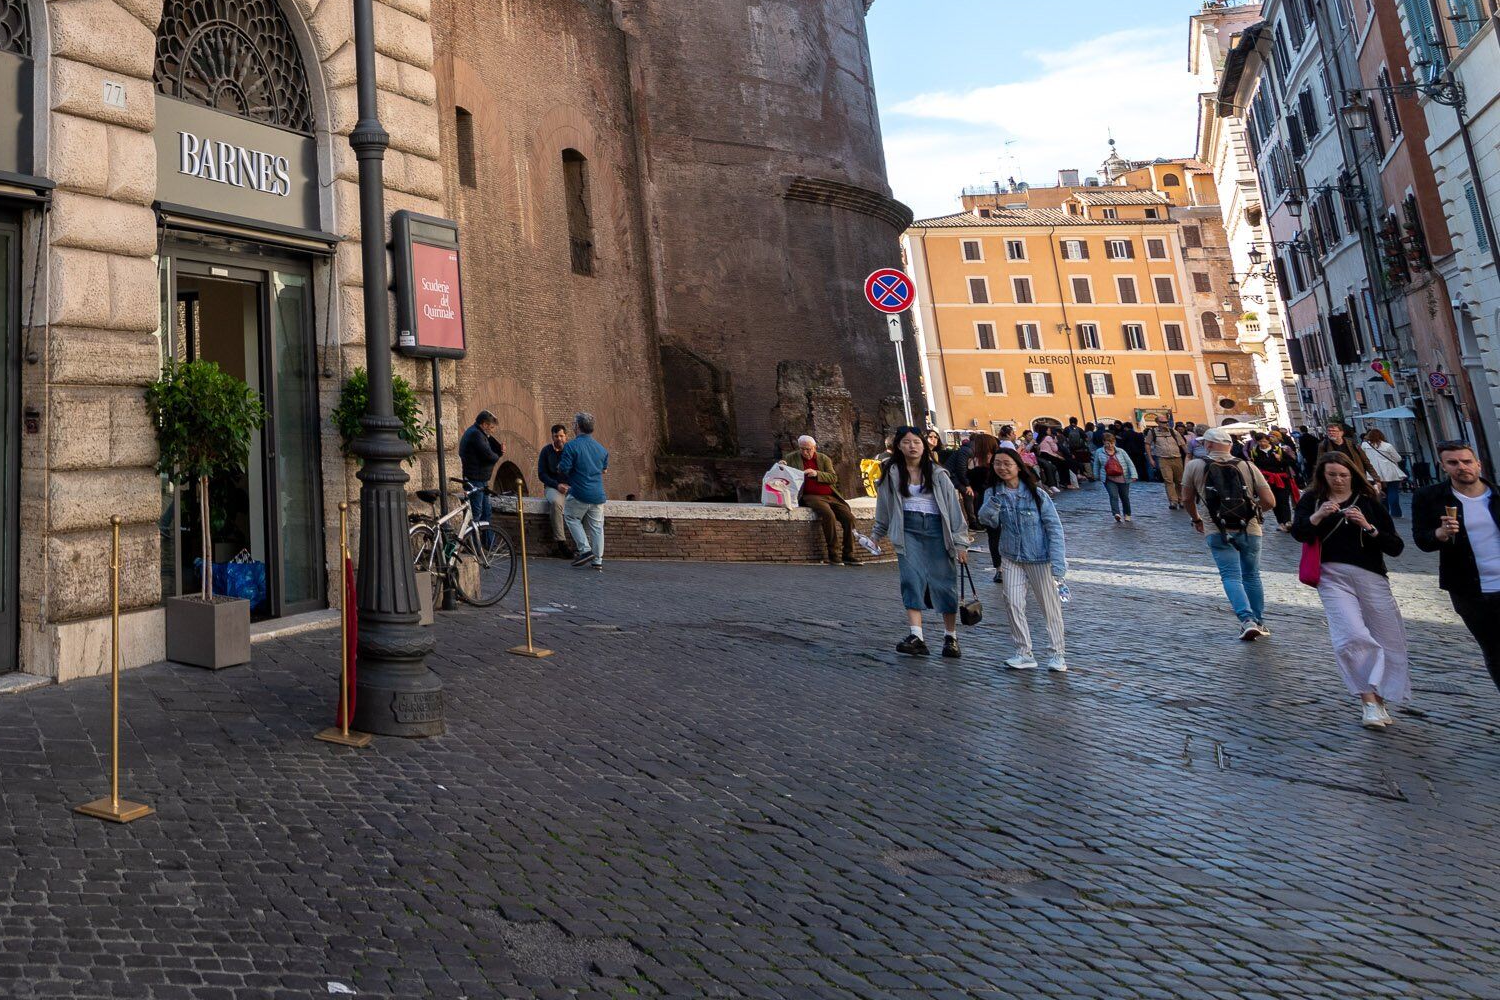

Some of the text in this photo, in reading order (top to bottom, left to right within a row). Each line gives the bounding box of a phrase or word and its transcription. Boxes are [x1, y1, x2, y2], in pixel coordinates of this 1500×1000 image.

[105, 82, 122, 104] 77
[177, 131, 291, 197] BARNES
[421, 277, 450, 294] Scuderie
[440, 294, 449, 307] del
[423, 304, 455, 320] Quirinale
[1028, 355, 1116, 366] ALBERGO ABRUZZI
